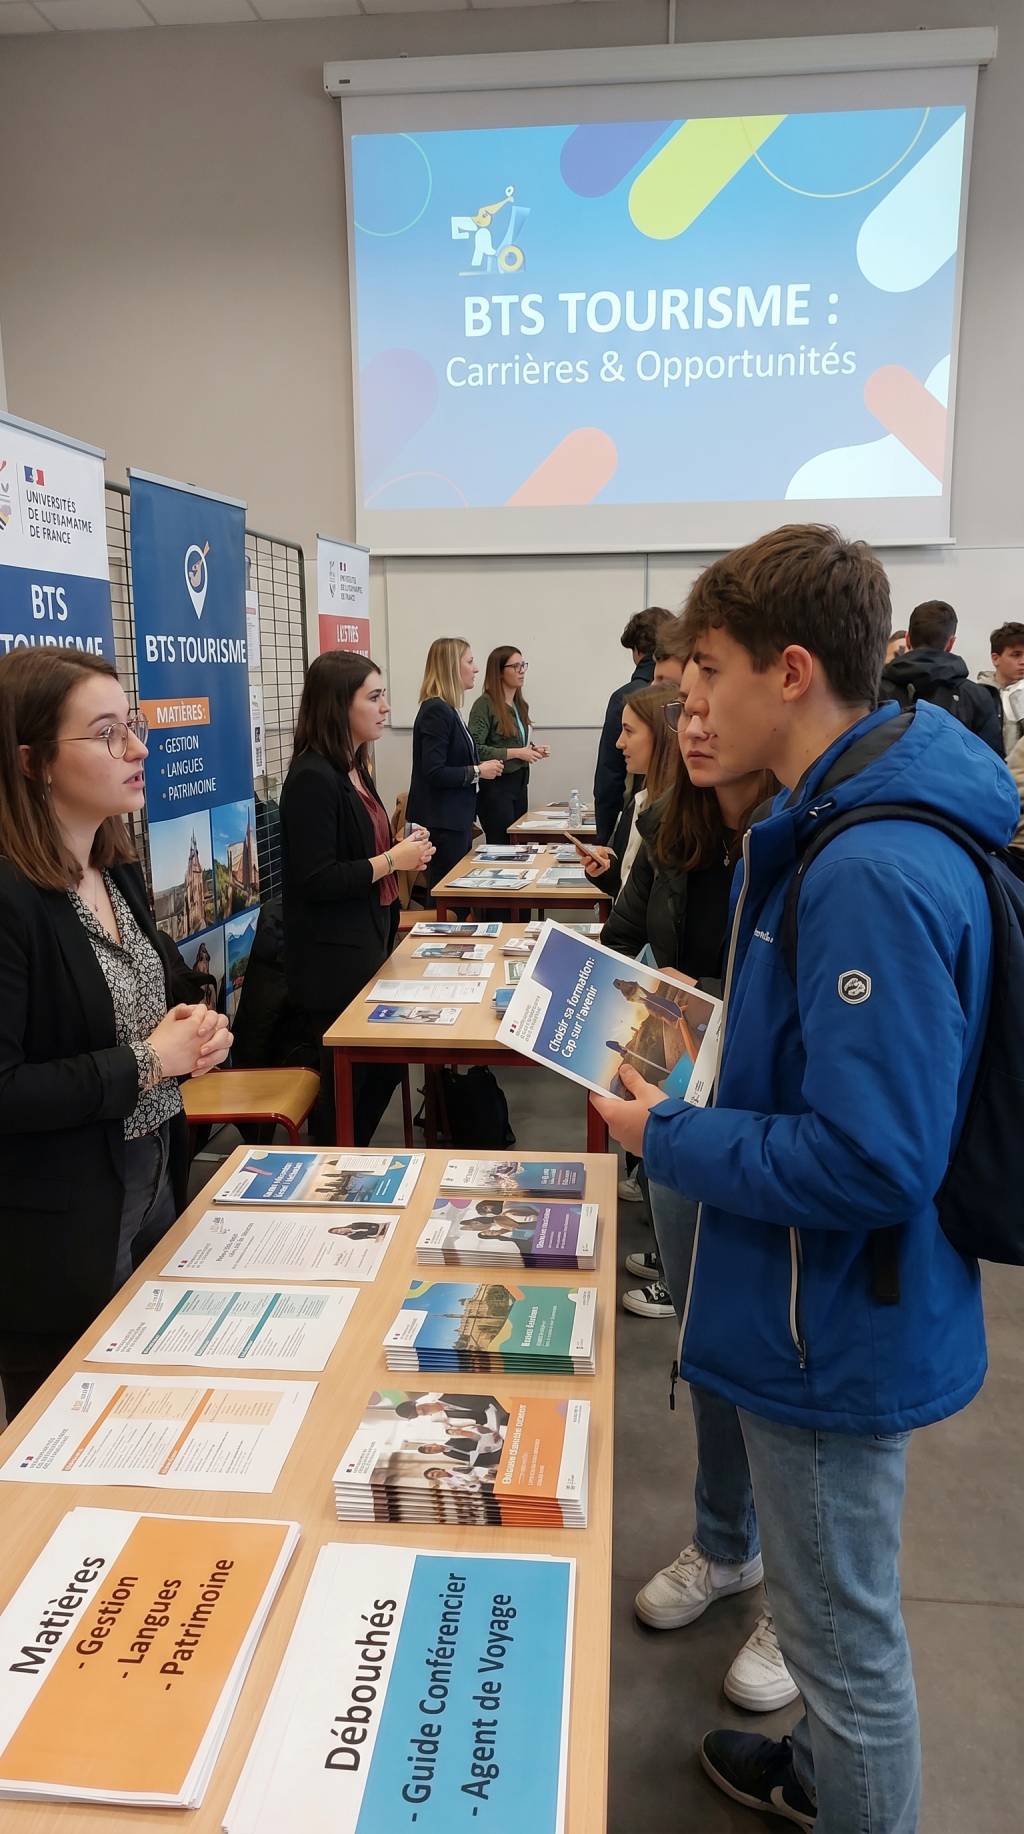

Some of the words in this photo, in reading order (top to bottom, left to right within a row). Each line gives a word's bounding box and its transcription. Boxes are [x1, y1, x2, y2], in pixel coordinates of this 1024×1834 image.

[464, 293, 546, 338] BTS
[558, 283, 811, 334] TOURISME
[828, 291, 840, 326] :
[445, 353, 590, 388] Carrières
[599, 350, 625, 383] &
[635, 342, 858, 388] Opportunités
[26, 489, 77, 514] UNIVERSITÉS
[28, 507, 40, 521] DE
[29, 524, 41, 539] DE
[43, 527, 72, 545] FRANCE
[31, 584, 69, 622] BTS
[145, 634, 177, 663] BTS
[177, 636, 247, 664] TOURISME
[156, 701, 207, 724] MATIÈRES:
[165, 735, 199, 754] GESTION
[167, 757, 204, 777] LANGUES
[168, 777, 217, 801] PATRIMOINE
[575, 985, 597, 1022] l'avenir
[548, 1018, 568, 1053] Choisir
[564, 1006, 575, 1020] sa
[561, 1037, 577, 1058] Cap
[571, 1020, 583, 1039] sur
[8, 1557, 106, 1674] Matières
[75, 1576, 139, 1655] Gestion
[117, 1579, 182, 1664] Langues
[159, 1559, 235, 1676] Patrimoine
[477, 1594, 517, 1674] Voyage
[418, 1572, 467, 1715] Conférencier
[324, 1599, 398, 1772] Débouchés
[472, 1681, 502, 1711] de
[401, 1723, 442, 1804] Guide
[460, 1718, 500, 1801] Agent
